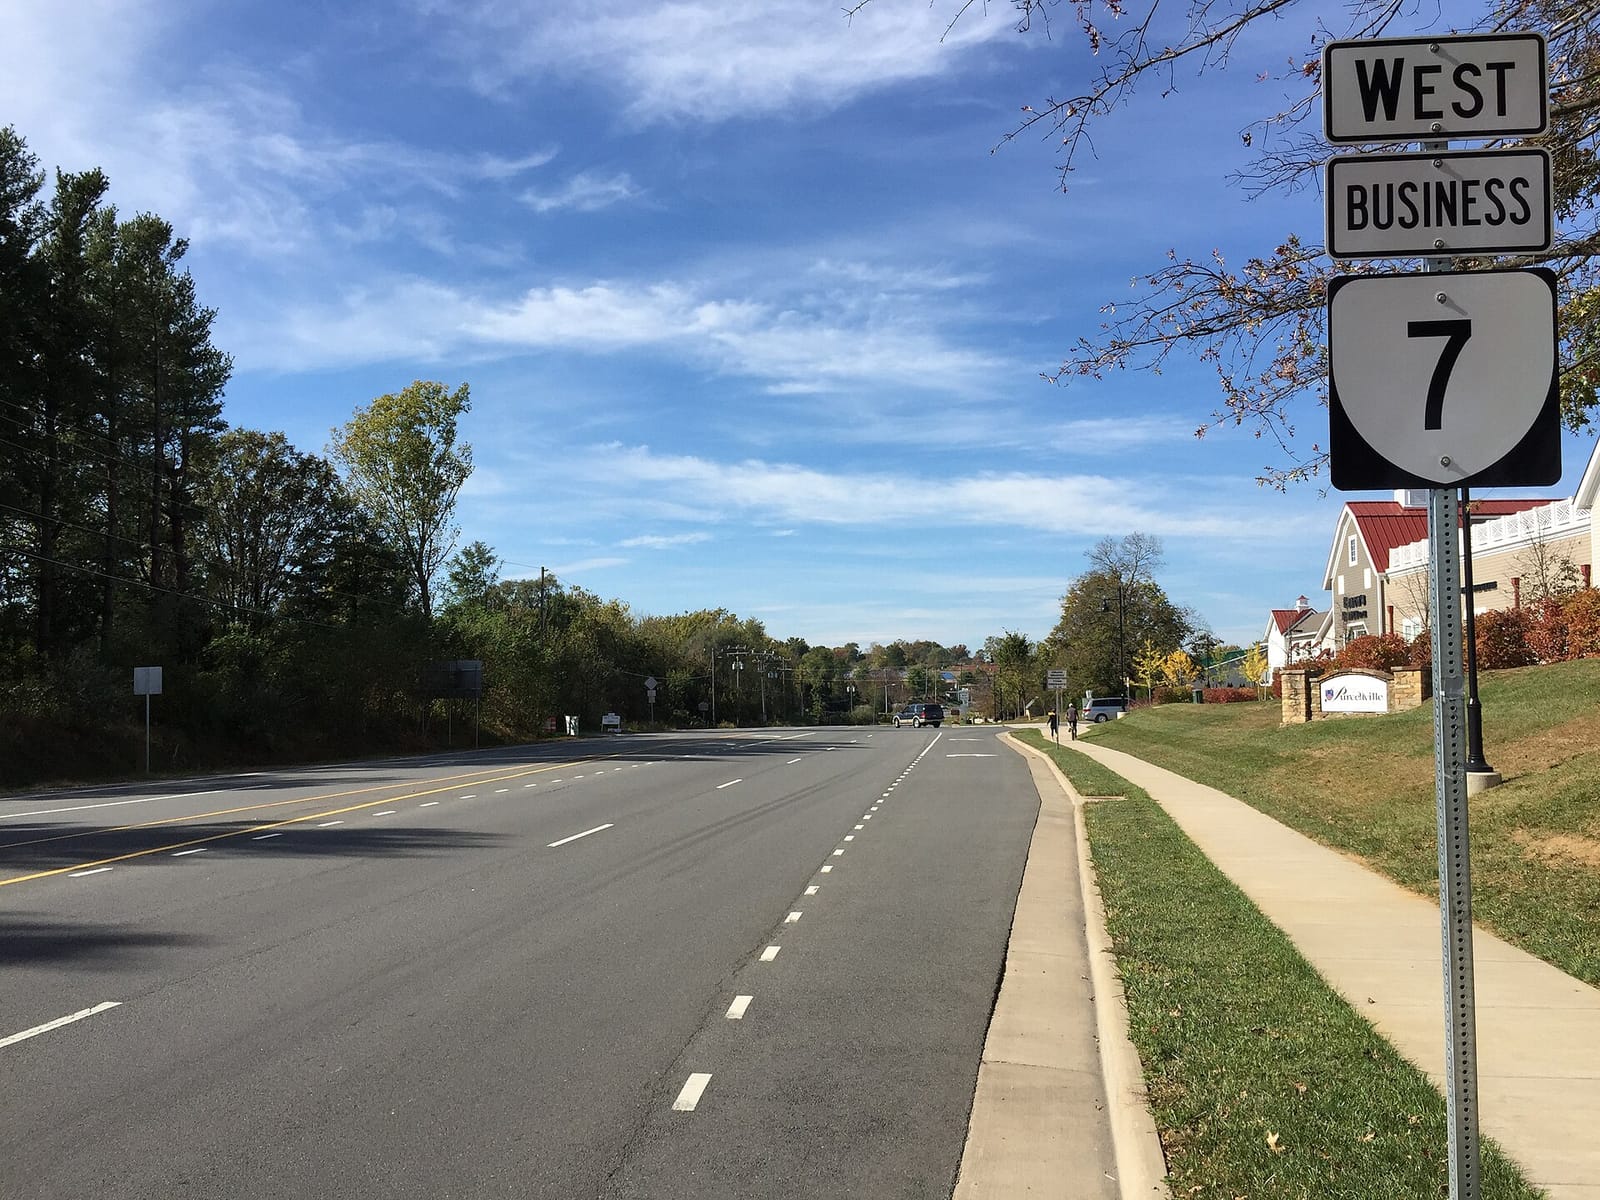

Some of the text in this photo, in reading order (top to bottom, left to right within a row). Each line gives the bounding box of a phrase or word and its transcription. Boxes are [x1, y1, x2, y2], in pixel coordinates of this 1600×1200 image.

[1355, 58, 1515, 122] WEST
[1347, 176, 1531, 230] BUSINESS
[1407, 319, 1471, 431] 7
